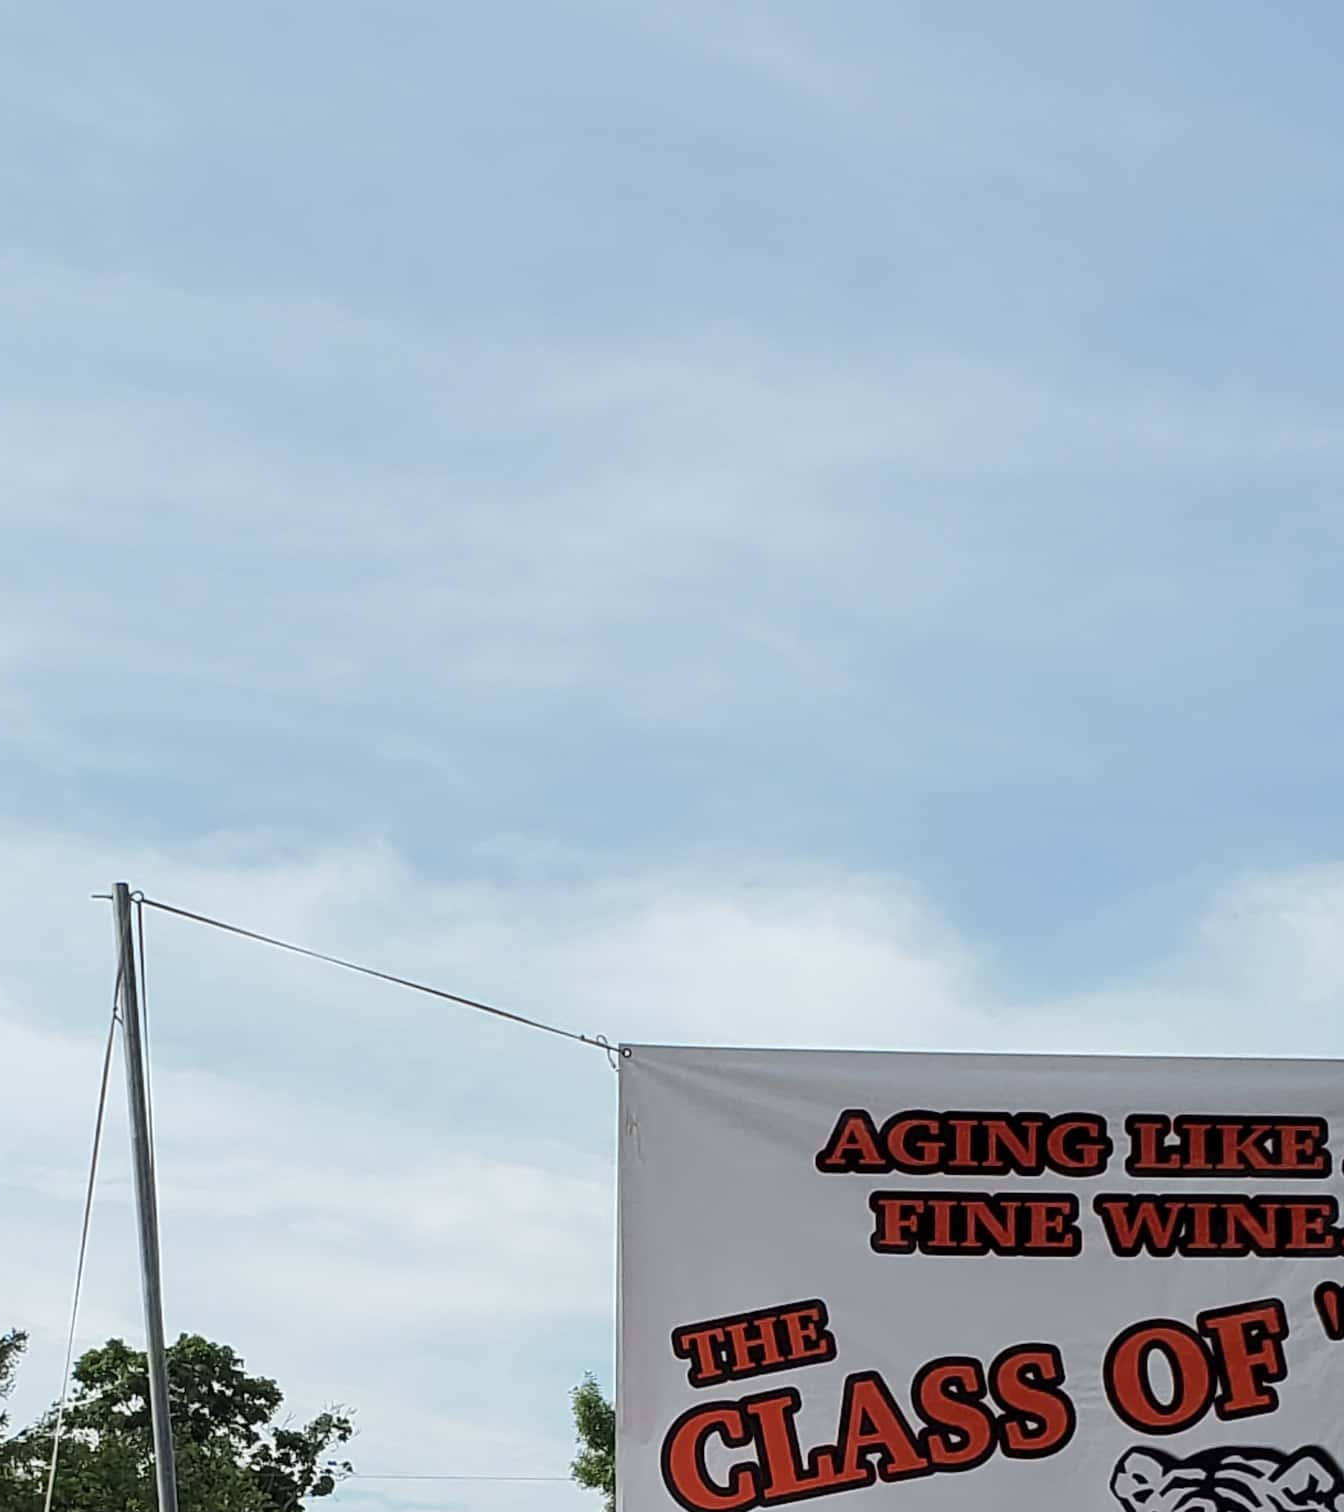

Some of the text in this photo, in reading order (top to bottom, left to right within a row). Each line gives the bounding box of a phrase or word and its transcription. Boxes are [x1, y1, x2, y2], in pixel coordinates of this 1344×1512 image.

[816, 1109, 1112, 1177] AGING
[1126, 1114, 1332, 1178] LIKE
[870, 1192, 1081, 1257] FINE
[672, 1299, 837, 1387] THE
[1103, 1297, 1288, 1434] OF
